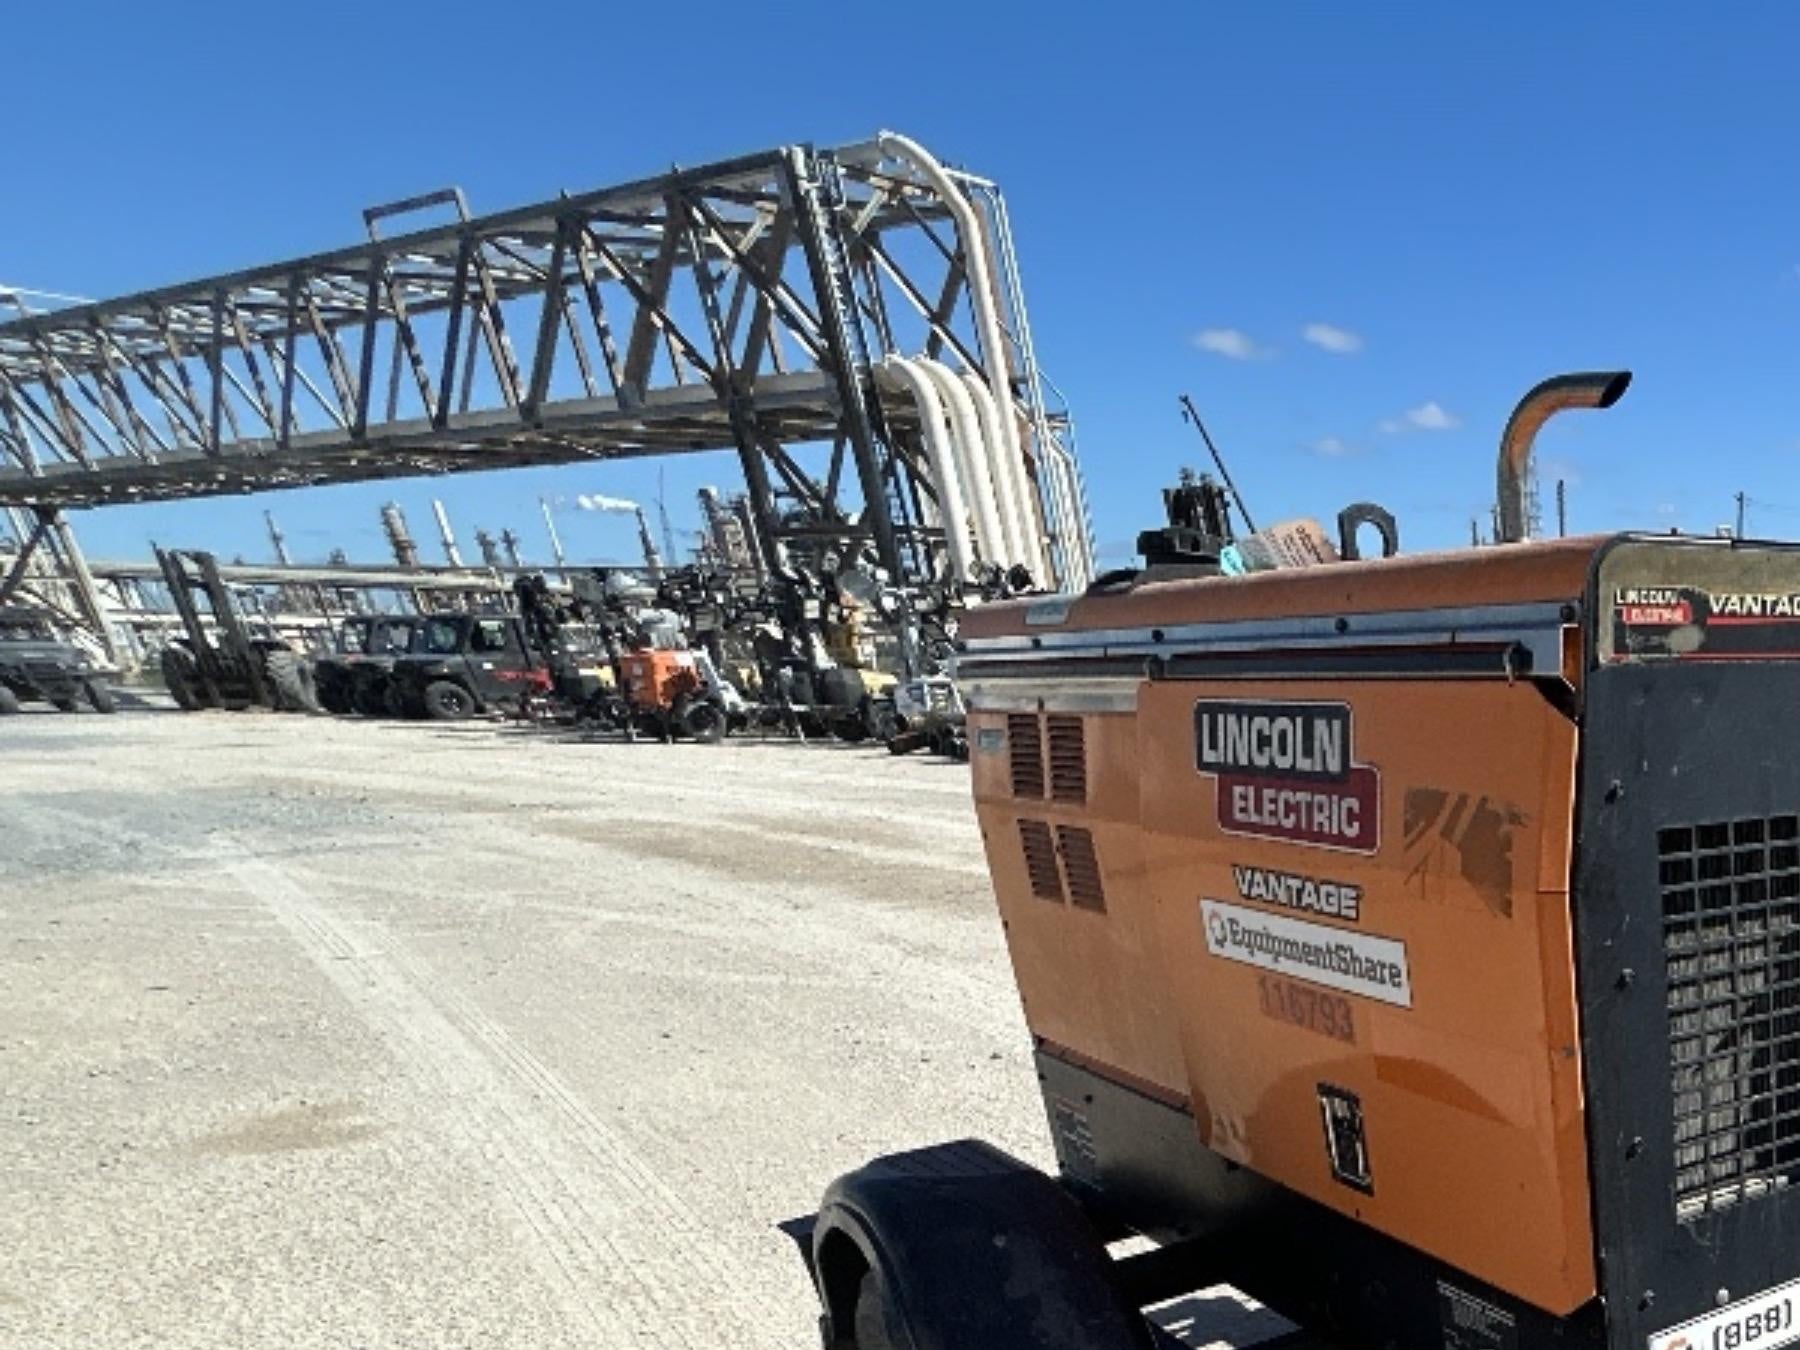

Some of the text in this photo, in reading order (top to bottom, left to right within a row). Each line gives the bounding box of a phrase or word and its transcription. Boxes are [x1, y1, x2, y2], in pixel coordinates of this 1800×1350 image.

[1202, 712, 1343, 774] LINCOLN
[1231, 784, 1361, 838] ELECTRIC
[1231, 863, 1360, 921] VANTAGE
[1227, 916, 1403, 988] EquipmentShare
